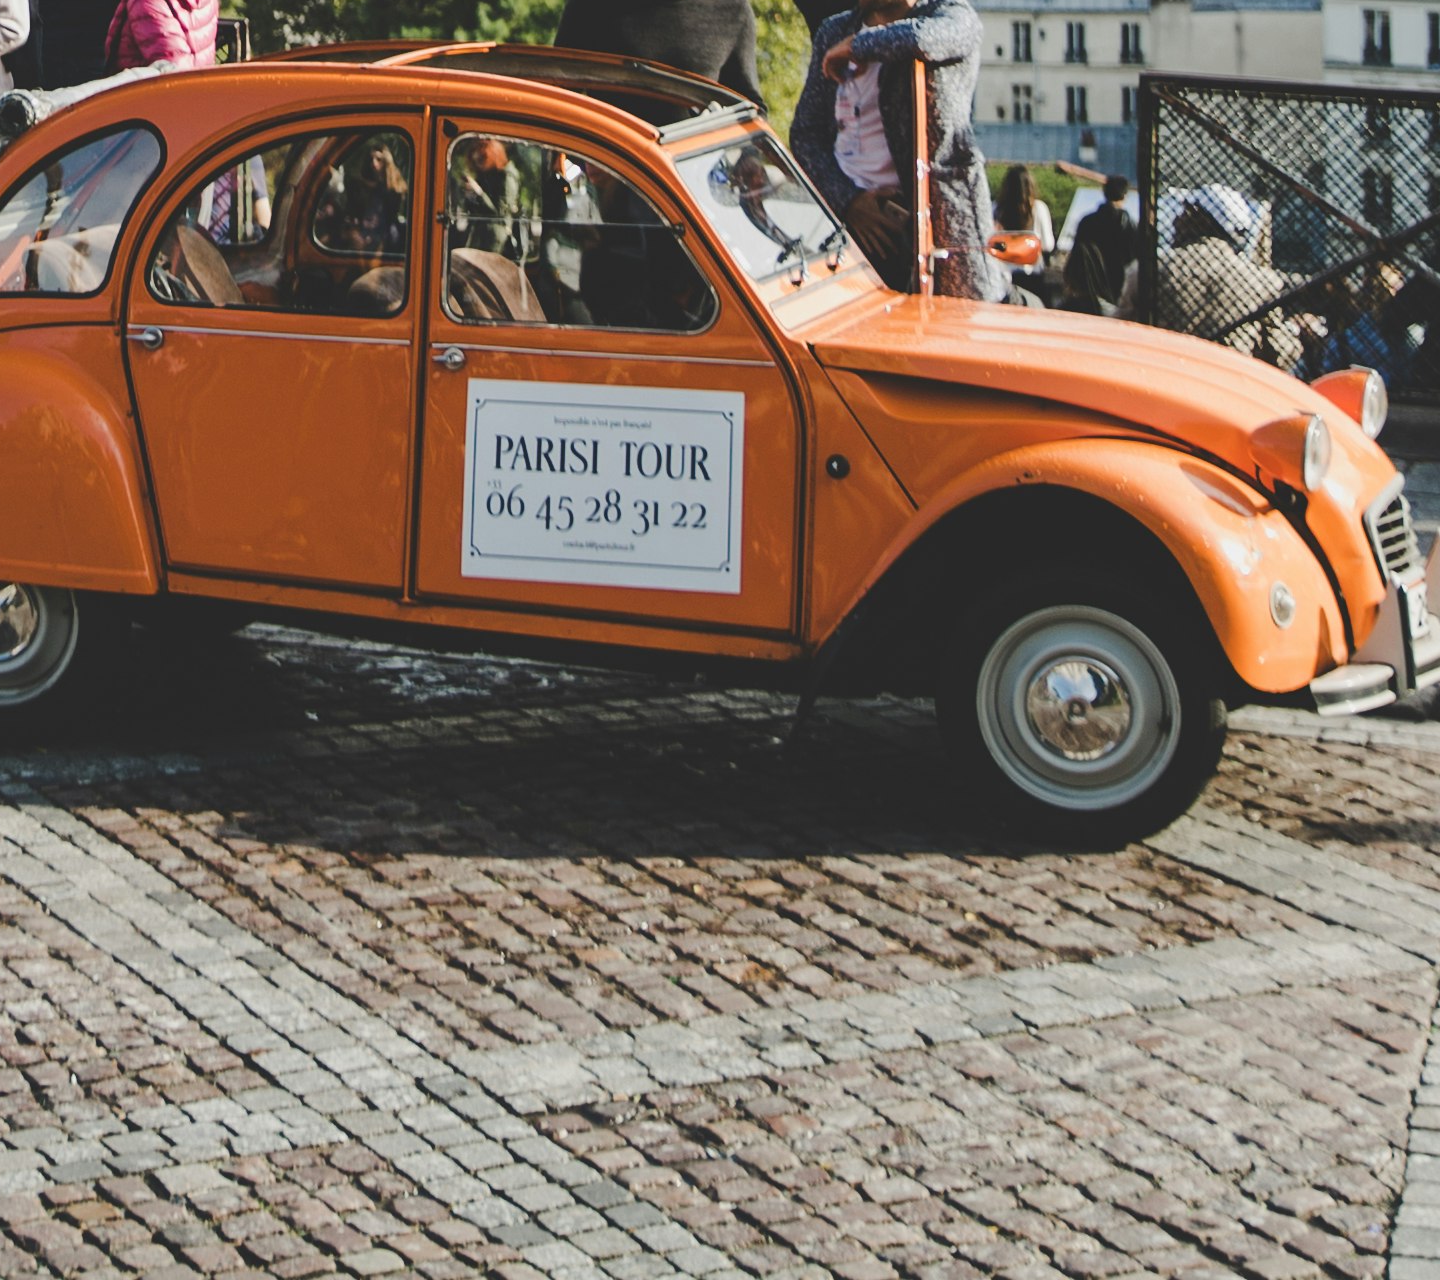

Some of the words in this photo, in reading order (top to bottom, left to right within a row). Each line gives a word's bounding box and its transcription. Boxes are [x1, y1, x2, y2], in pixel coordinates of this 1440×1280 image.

[494, 434, 600, 475] PARISI
[619, 440, 712, 482] TOUR
[486, 482, 526, 519] 06
[535, 494, 574, 532] 45
[584, 488, 623, 524] 28
[631, 499, 661, 537] 31
[670, 501, 708, 529] 22
